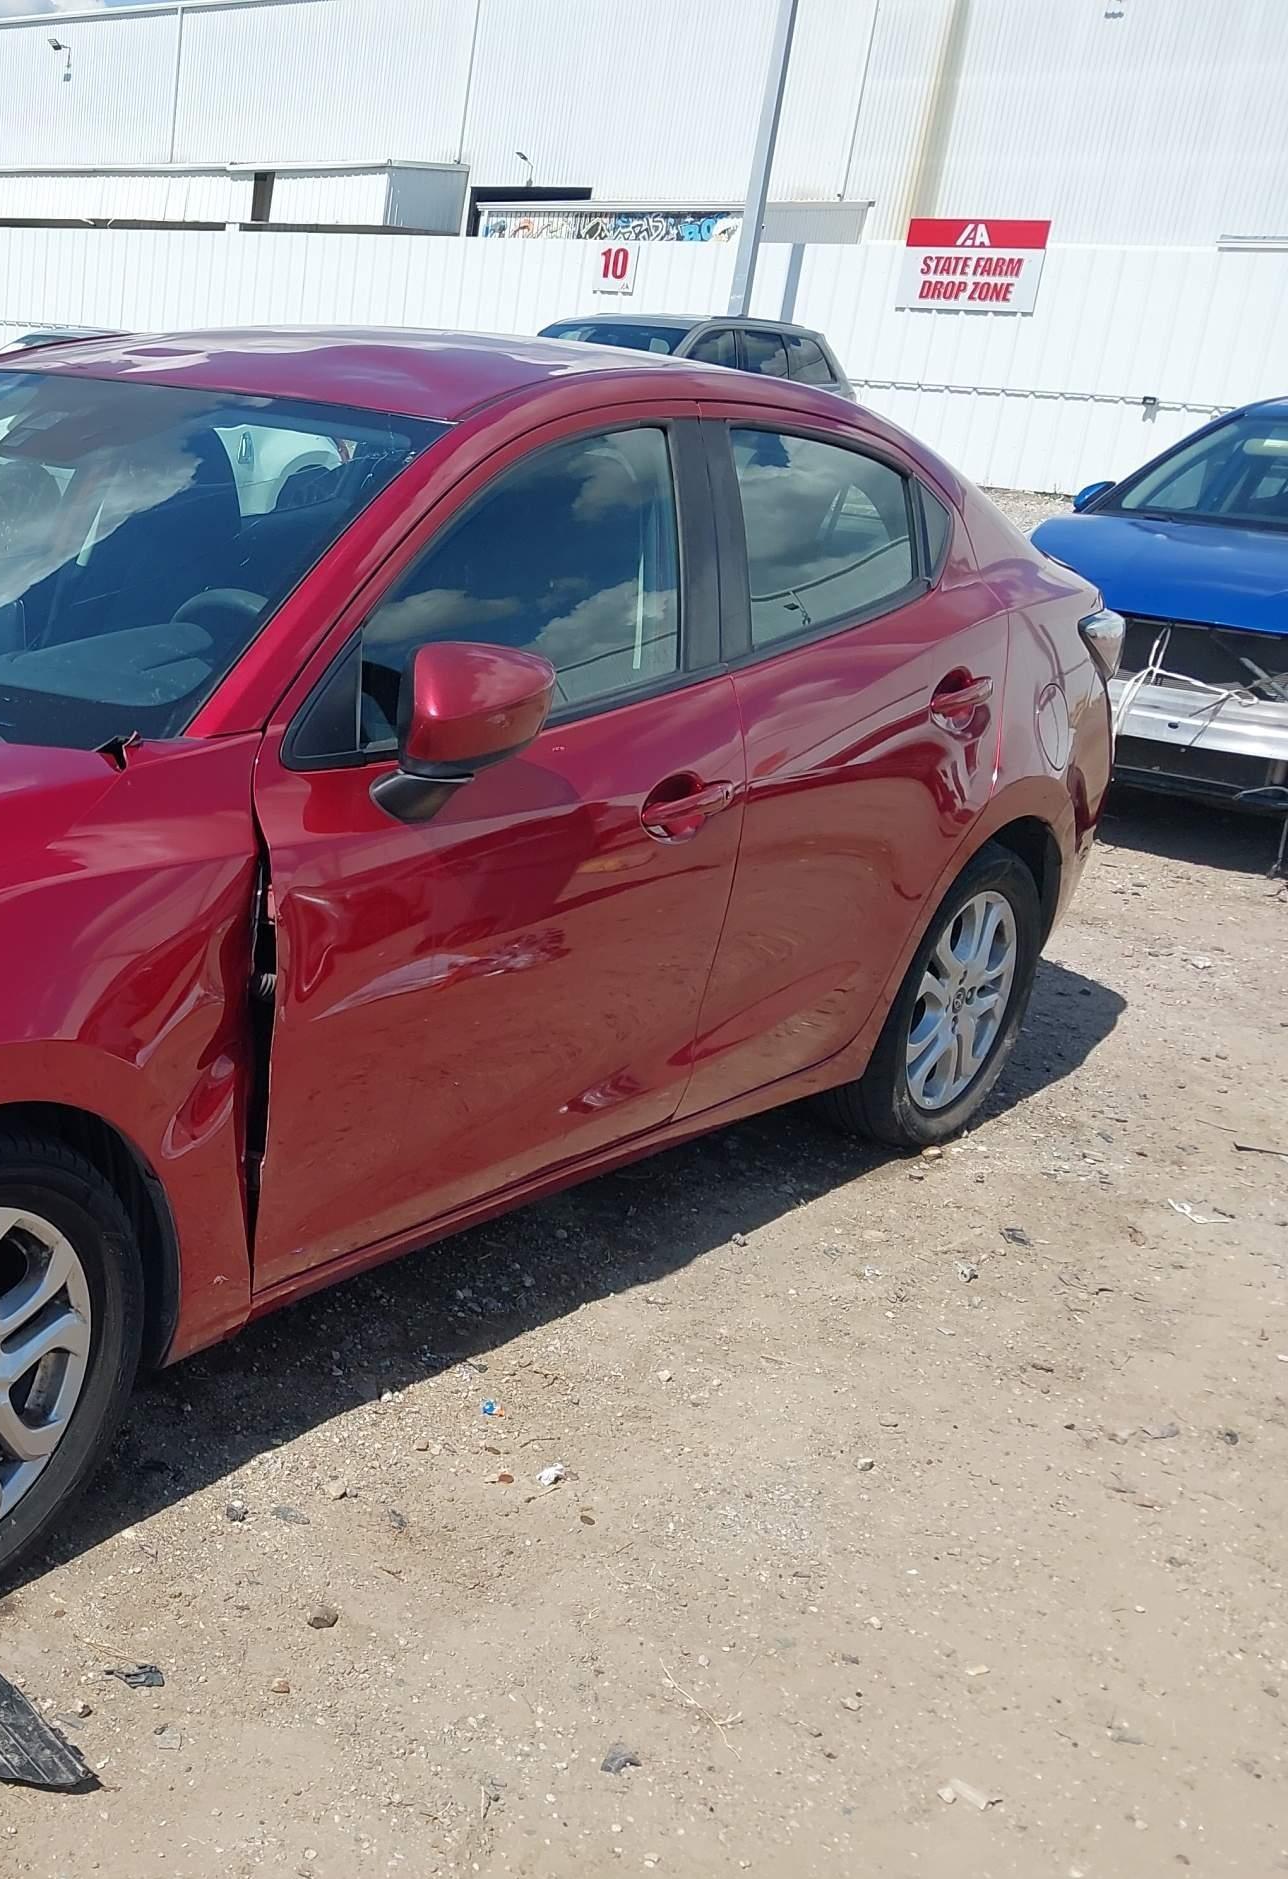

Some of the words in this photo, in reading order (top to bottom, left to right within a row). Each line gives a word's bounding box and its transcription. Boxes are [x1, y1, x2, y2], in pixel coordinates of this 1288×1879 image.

[600, 248, 630, 280] 10
[920, 256, 970, 276] STATE
[972, 257, 1024, 277] FARM
[919, 280, 967, 300] DROP
[968, 282, 1015, 302] ZONE
